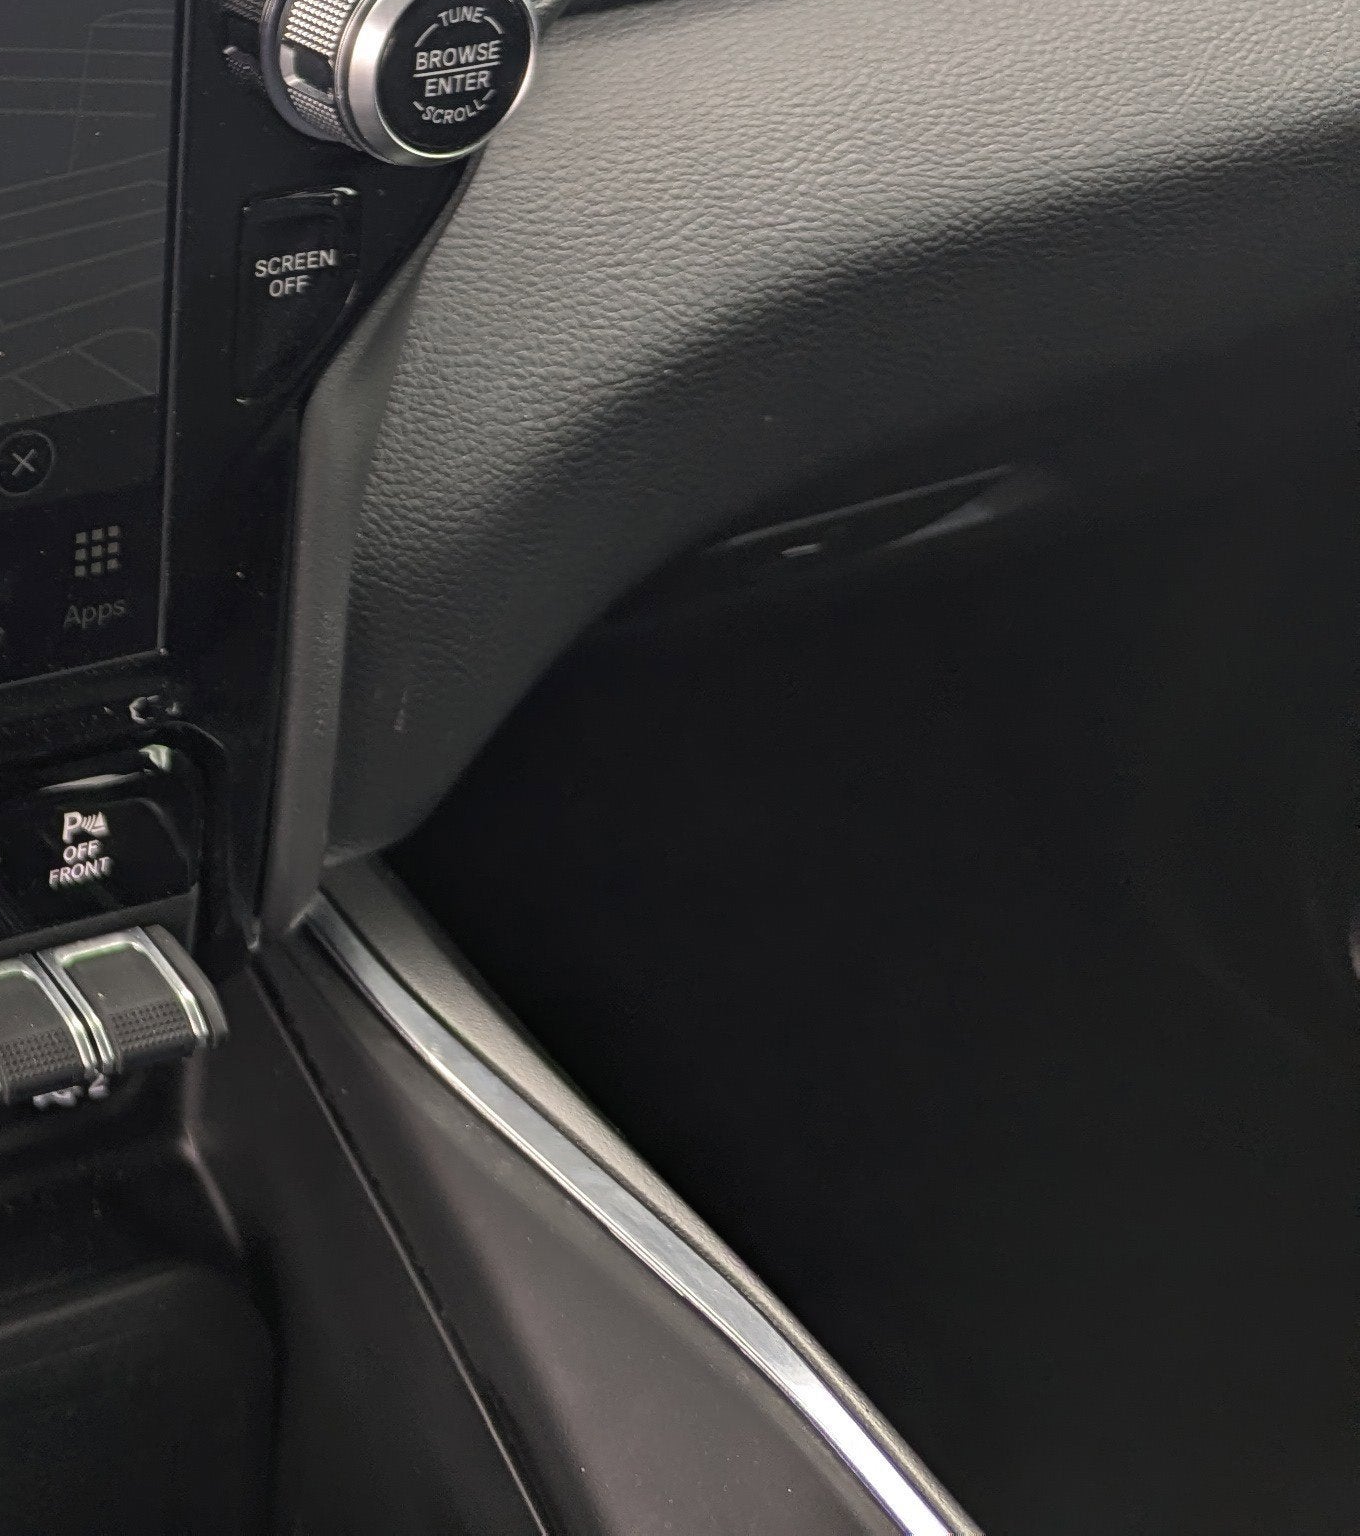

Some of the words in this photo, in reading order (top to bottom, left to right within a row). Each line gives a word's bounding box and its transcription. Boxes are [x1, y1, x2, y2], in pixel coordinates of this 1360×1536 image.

[437, 5, 488, 28] TUNE
[414, 40, 502, 71] BROWSE
[424, 70, 493, 99] ENTER
[421, 99, 487, 125] SCROLL
[254, 248, 337, 280] SCREEN
[268, 275, 311, 298] OFF
[63, 595, 127, 630] Apps
[63, 839, 101, 865] OFF
[48, 855, 112, 889] FRONT
